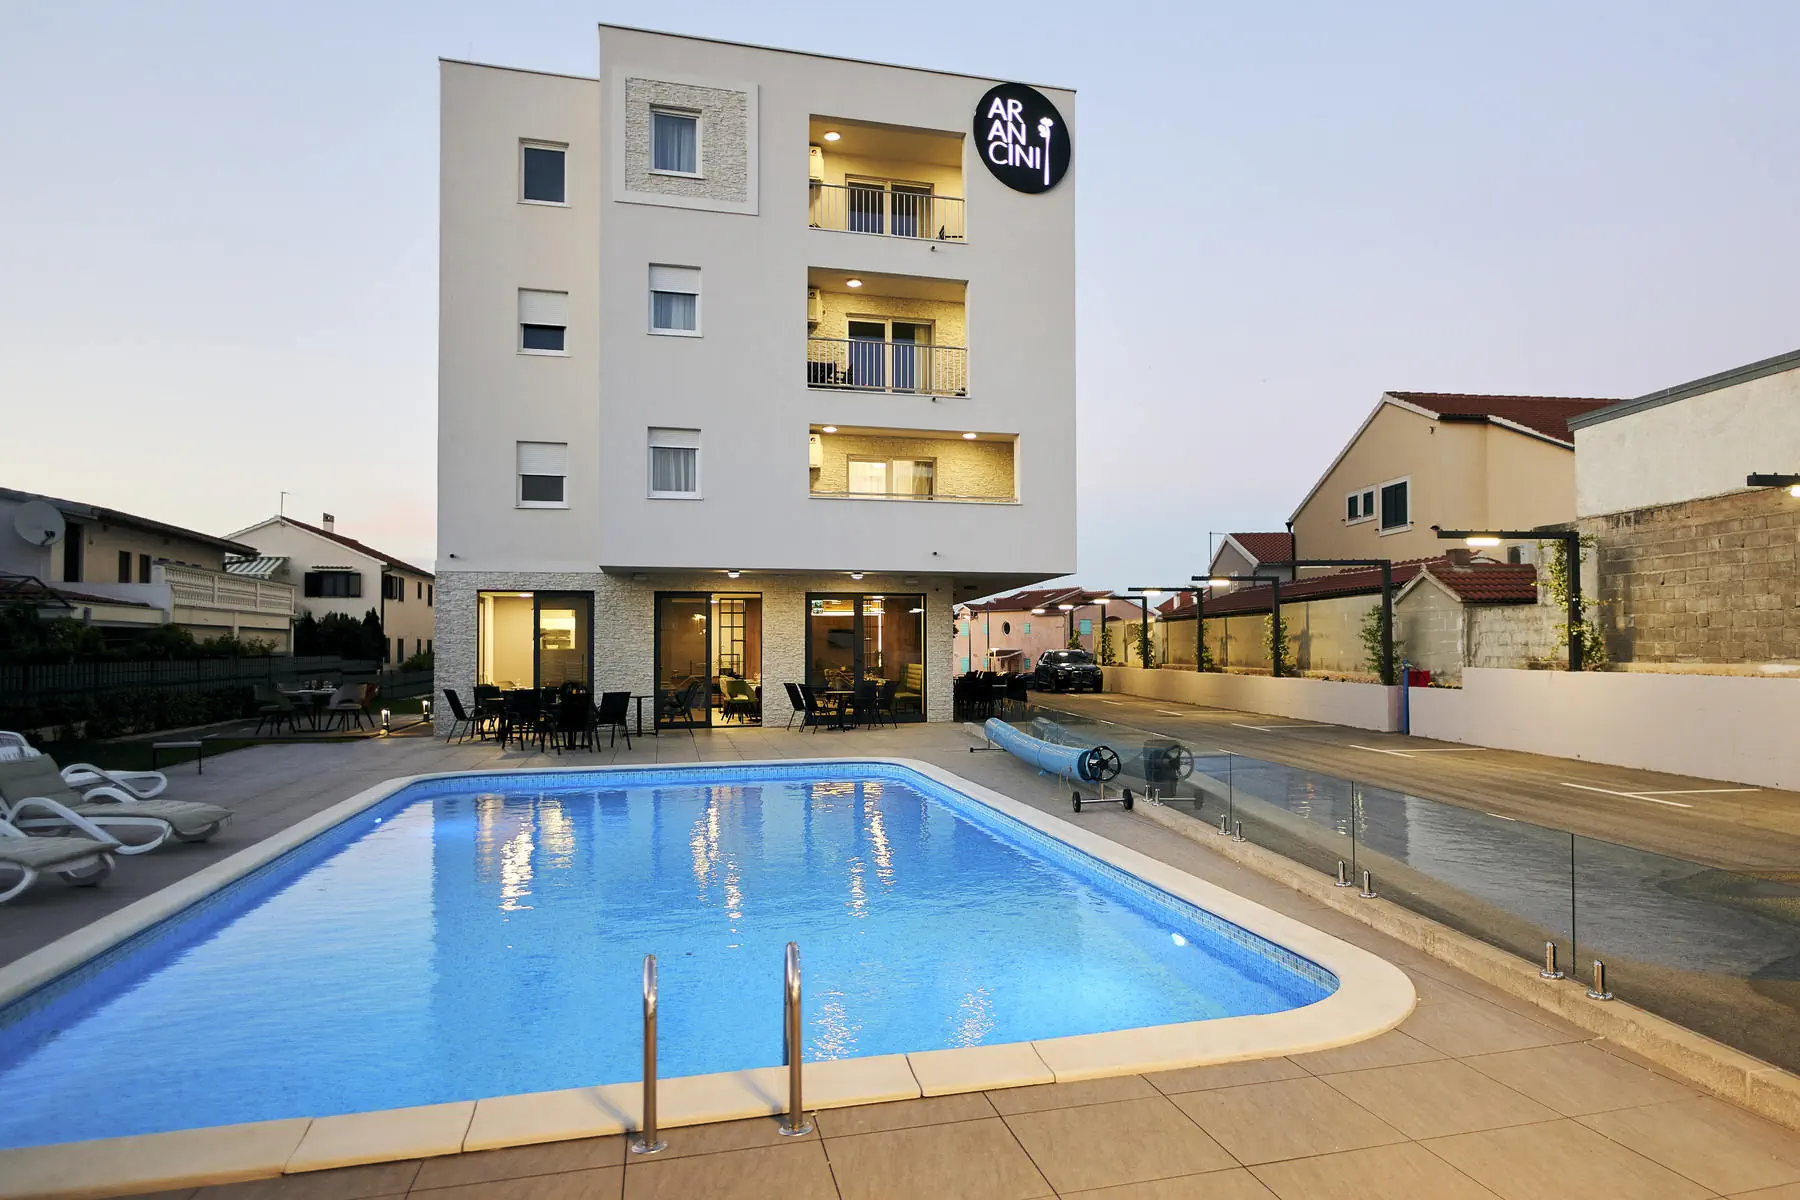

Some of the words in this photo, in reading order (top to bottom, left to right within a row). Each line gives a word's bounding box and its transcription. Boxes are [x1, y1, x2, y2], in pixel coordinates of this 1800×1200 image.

[987, 97, 1025, 124] AR
[987, 119, 1027, 146] AN
[988, 141, 1041, 170] CINI
